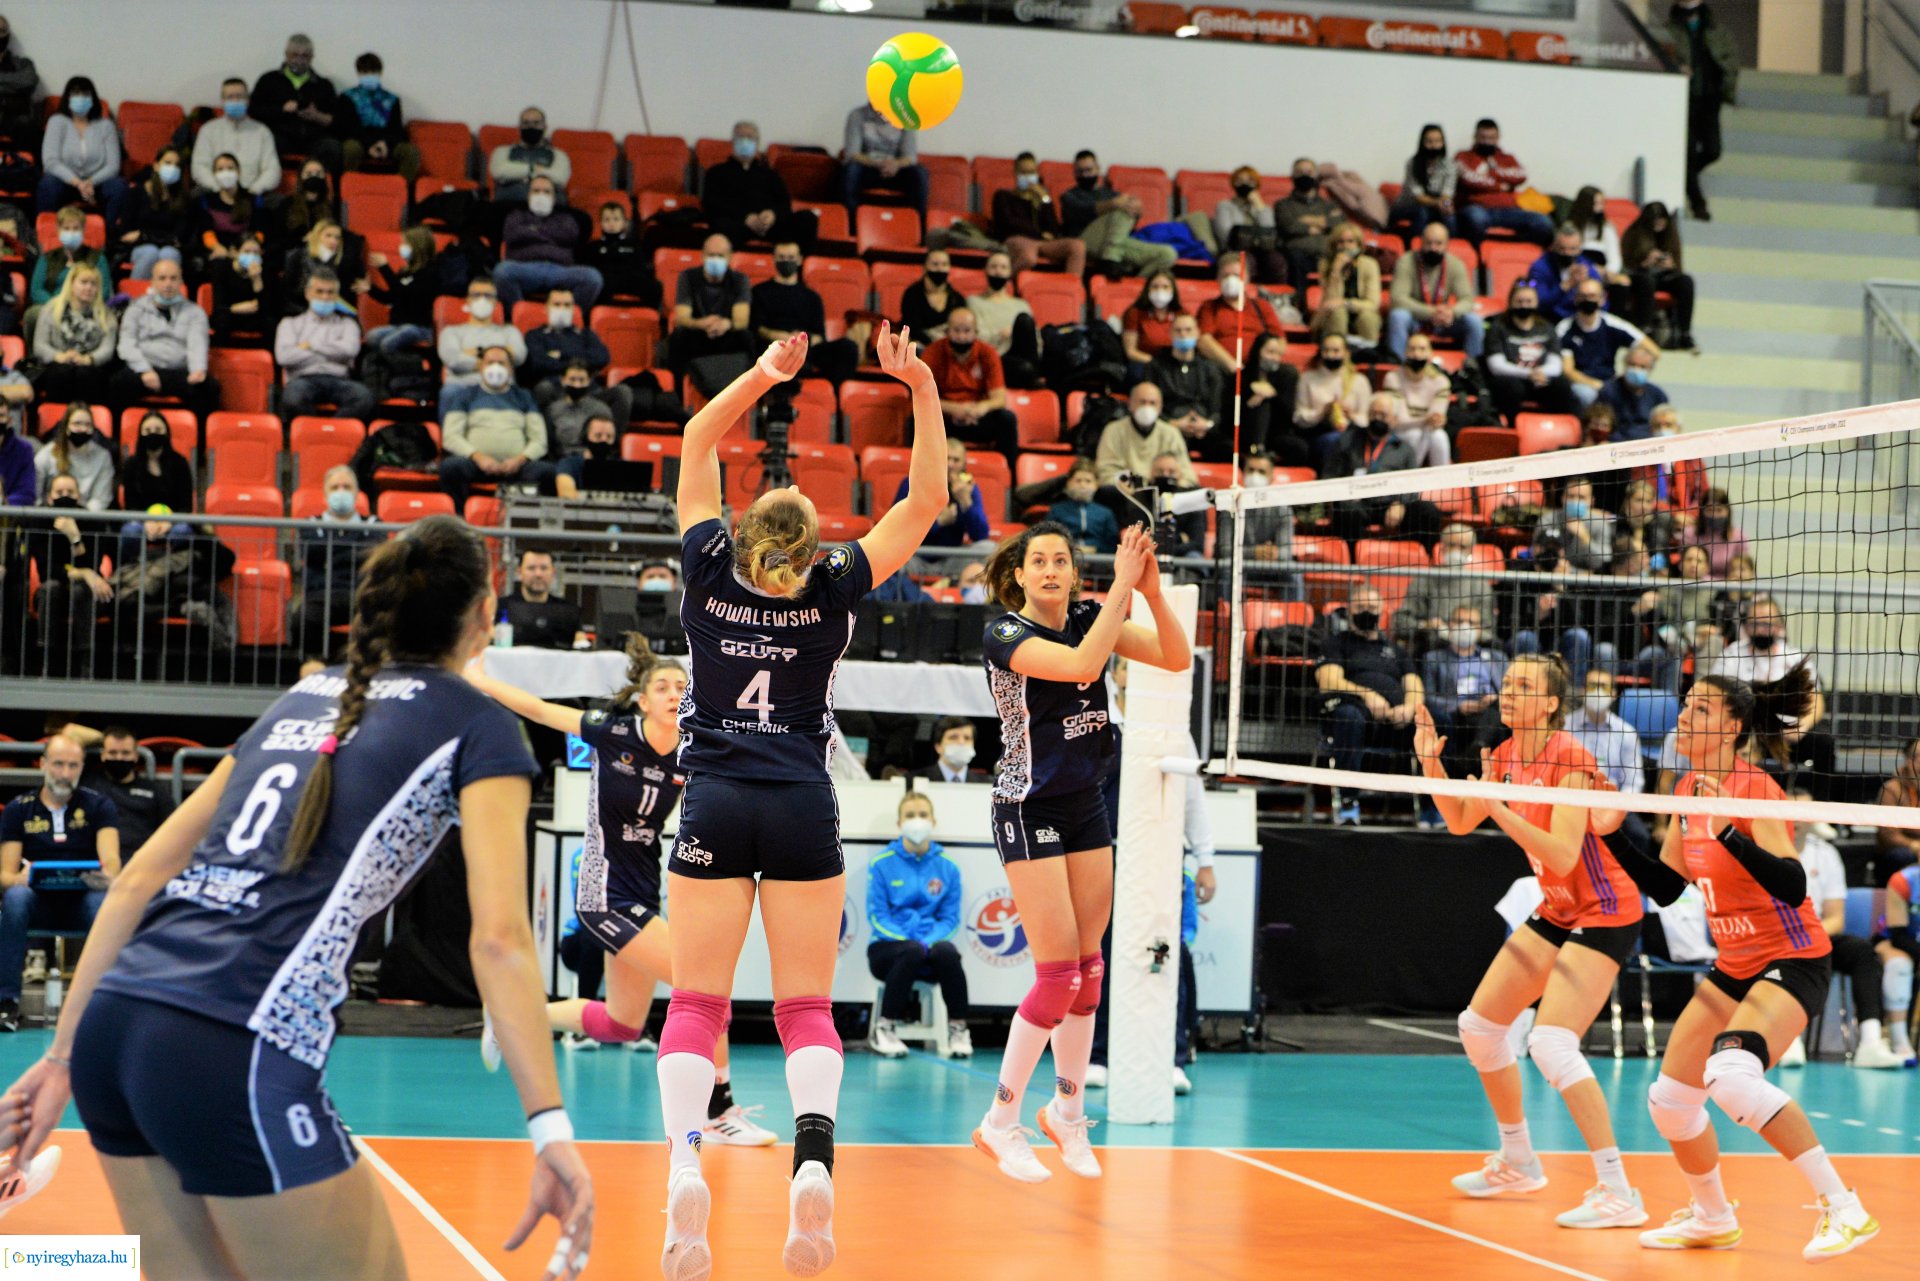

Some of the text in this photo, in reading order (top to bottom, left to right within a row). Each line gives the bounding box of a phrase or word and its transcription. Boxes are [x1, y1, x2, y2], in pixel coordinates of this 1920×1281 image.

[705, 596, 822, 628] KOWALEWSKA
[736, 670, 775, 723] 4
[722, 719, 790, 733] CHEMIK
[226, 763, 298, 856] 6
[637, 784, 659, 816] 11
[1004, 821, 1015, 843] 9
[598, 920, 621, 937] 11
[286, 1103, 319, 1148] 6
